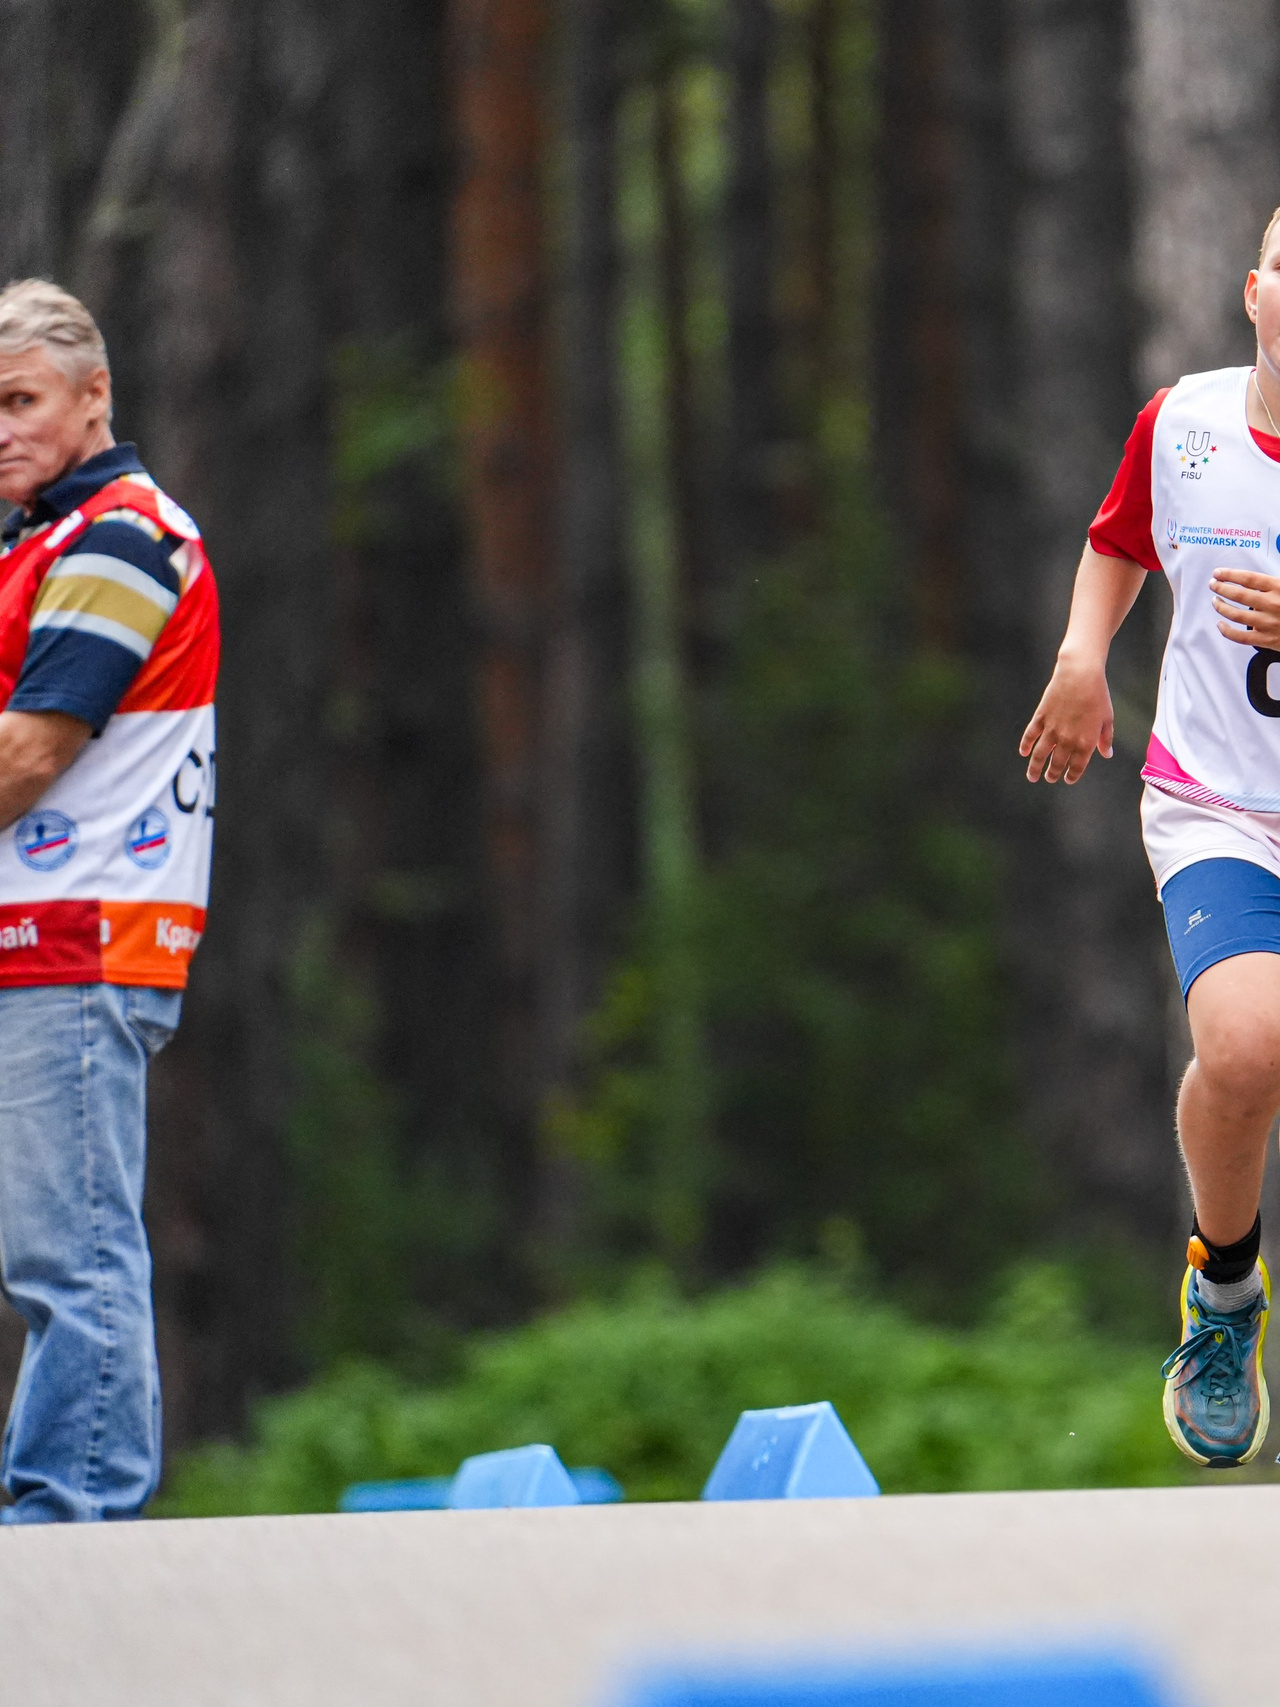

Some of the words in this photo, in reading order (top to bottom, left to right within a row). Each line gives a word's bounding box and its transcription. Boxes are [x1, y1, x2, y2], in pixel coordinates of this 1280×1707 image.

[1181, 471, 1202, 480] FISU
[1188, 526, 1212, 535] WINTER
[1212, 528, 1262, 538] UNIVERSIADE
[1179, 535, 1238, 547] KRASNOYARSK
[1239, 539, 1261, 548] 2019
